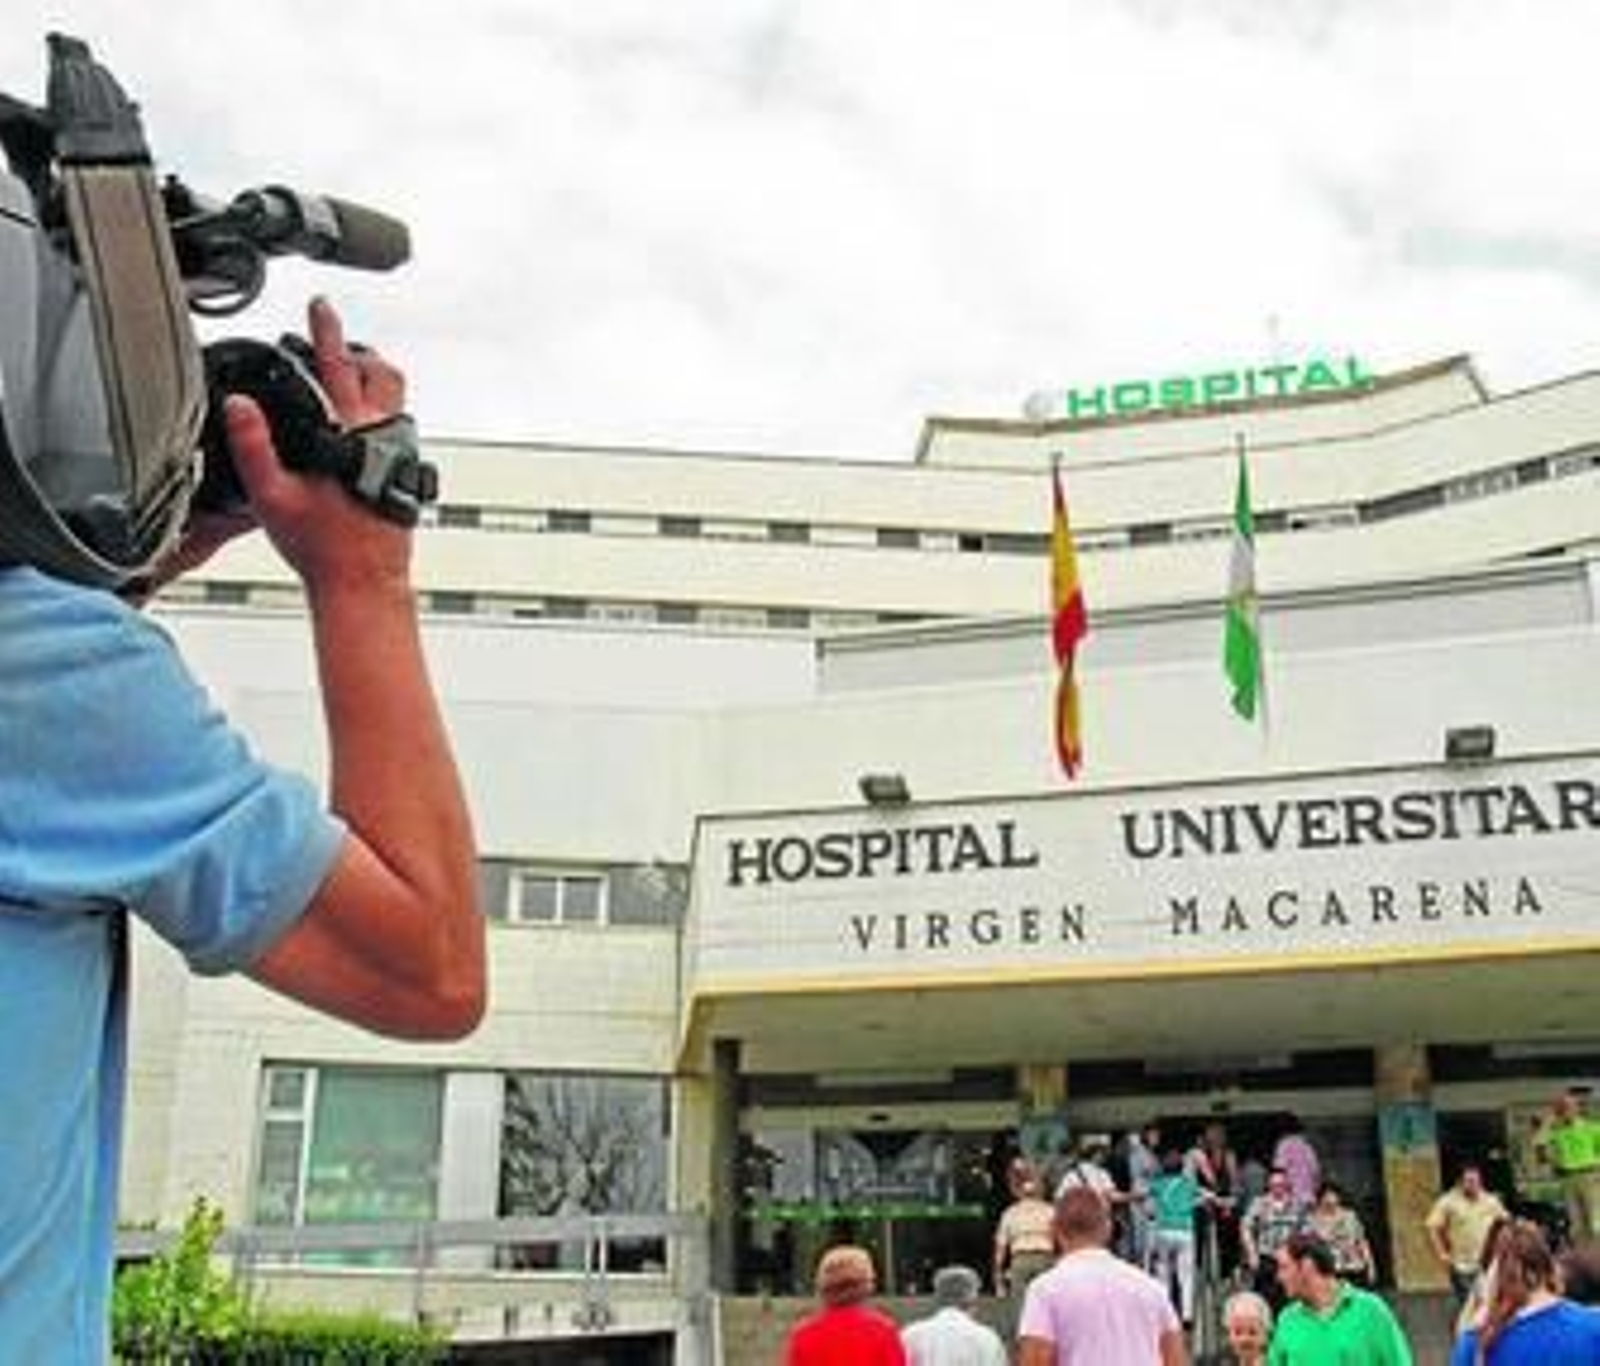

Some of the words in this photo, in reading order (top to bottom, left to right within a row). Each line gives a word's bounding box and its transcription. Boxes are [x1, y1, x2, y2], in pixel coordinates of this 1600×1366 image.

[1066, 355, 1375, 419] HOSPITAL
[727, 821, 1039, 886] HOSPITAL
[1121, 780, 1600, 859] UNIVERSITAR
[851, 904, 1087, 951] VIRGEN
[1169, 876, 1543, 935] MACARENA
